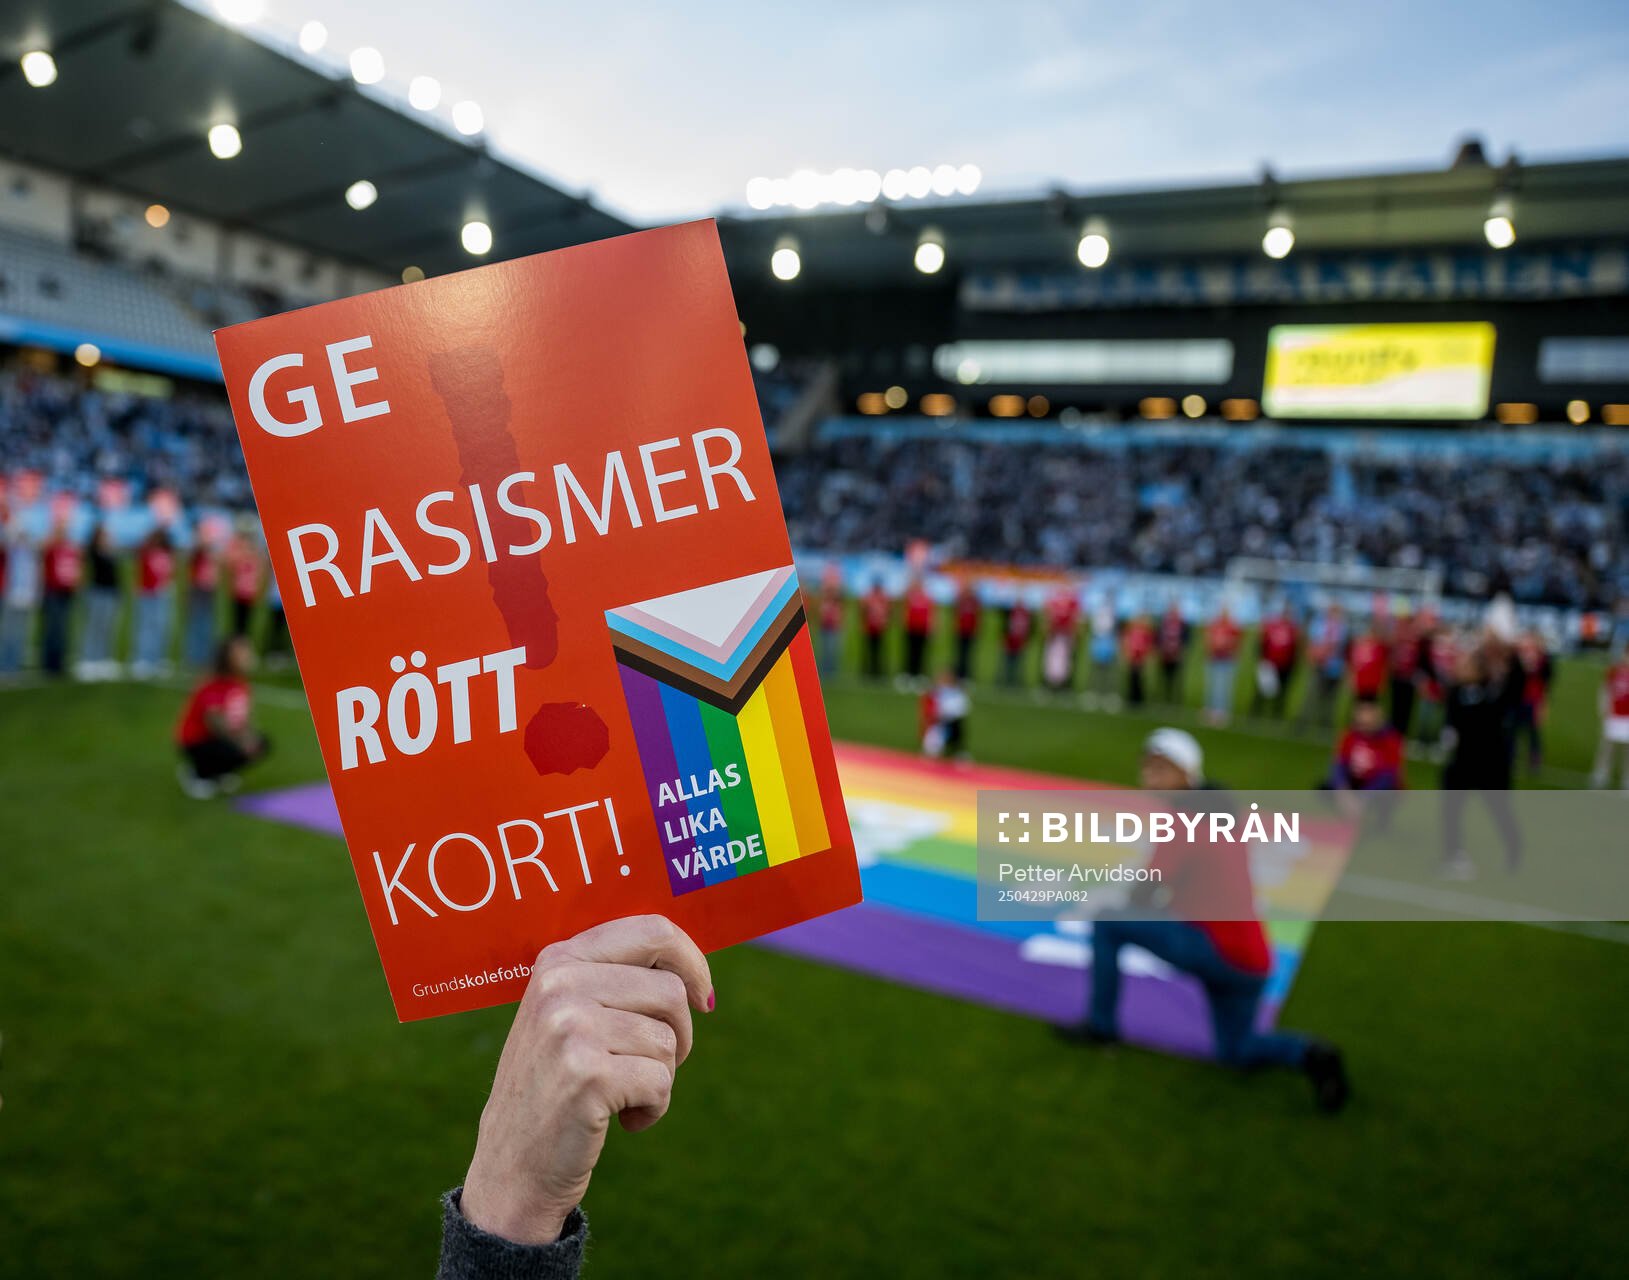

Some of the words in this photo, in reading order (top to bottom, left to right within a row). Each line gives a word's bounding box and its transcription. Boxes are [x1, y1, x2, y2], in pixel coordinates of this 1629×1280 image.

[248, 335, 391, 438] GE
[287, 427, 757, 608] RASISMER
[336, 646, 527, 771] RÖTT
[658, 763, 742, 808] ALLAS
[664, 807, 728, 844] LIKA
[372, 797, 631, 926] KORT!
[671, 833, 763, 879] VÄRDE
